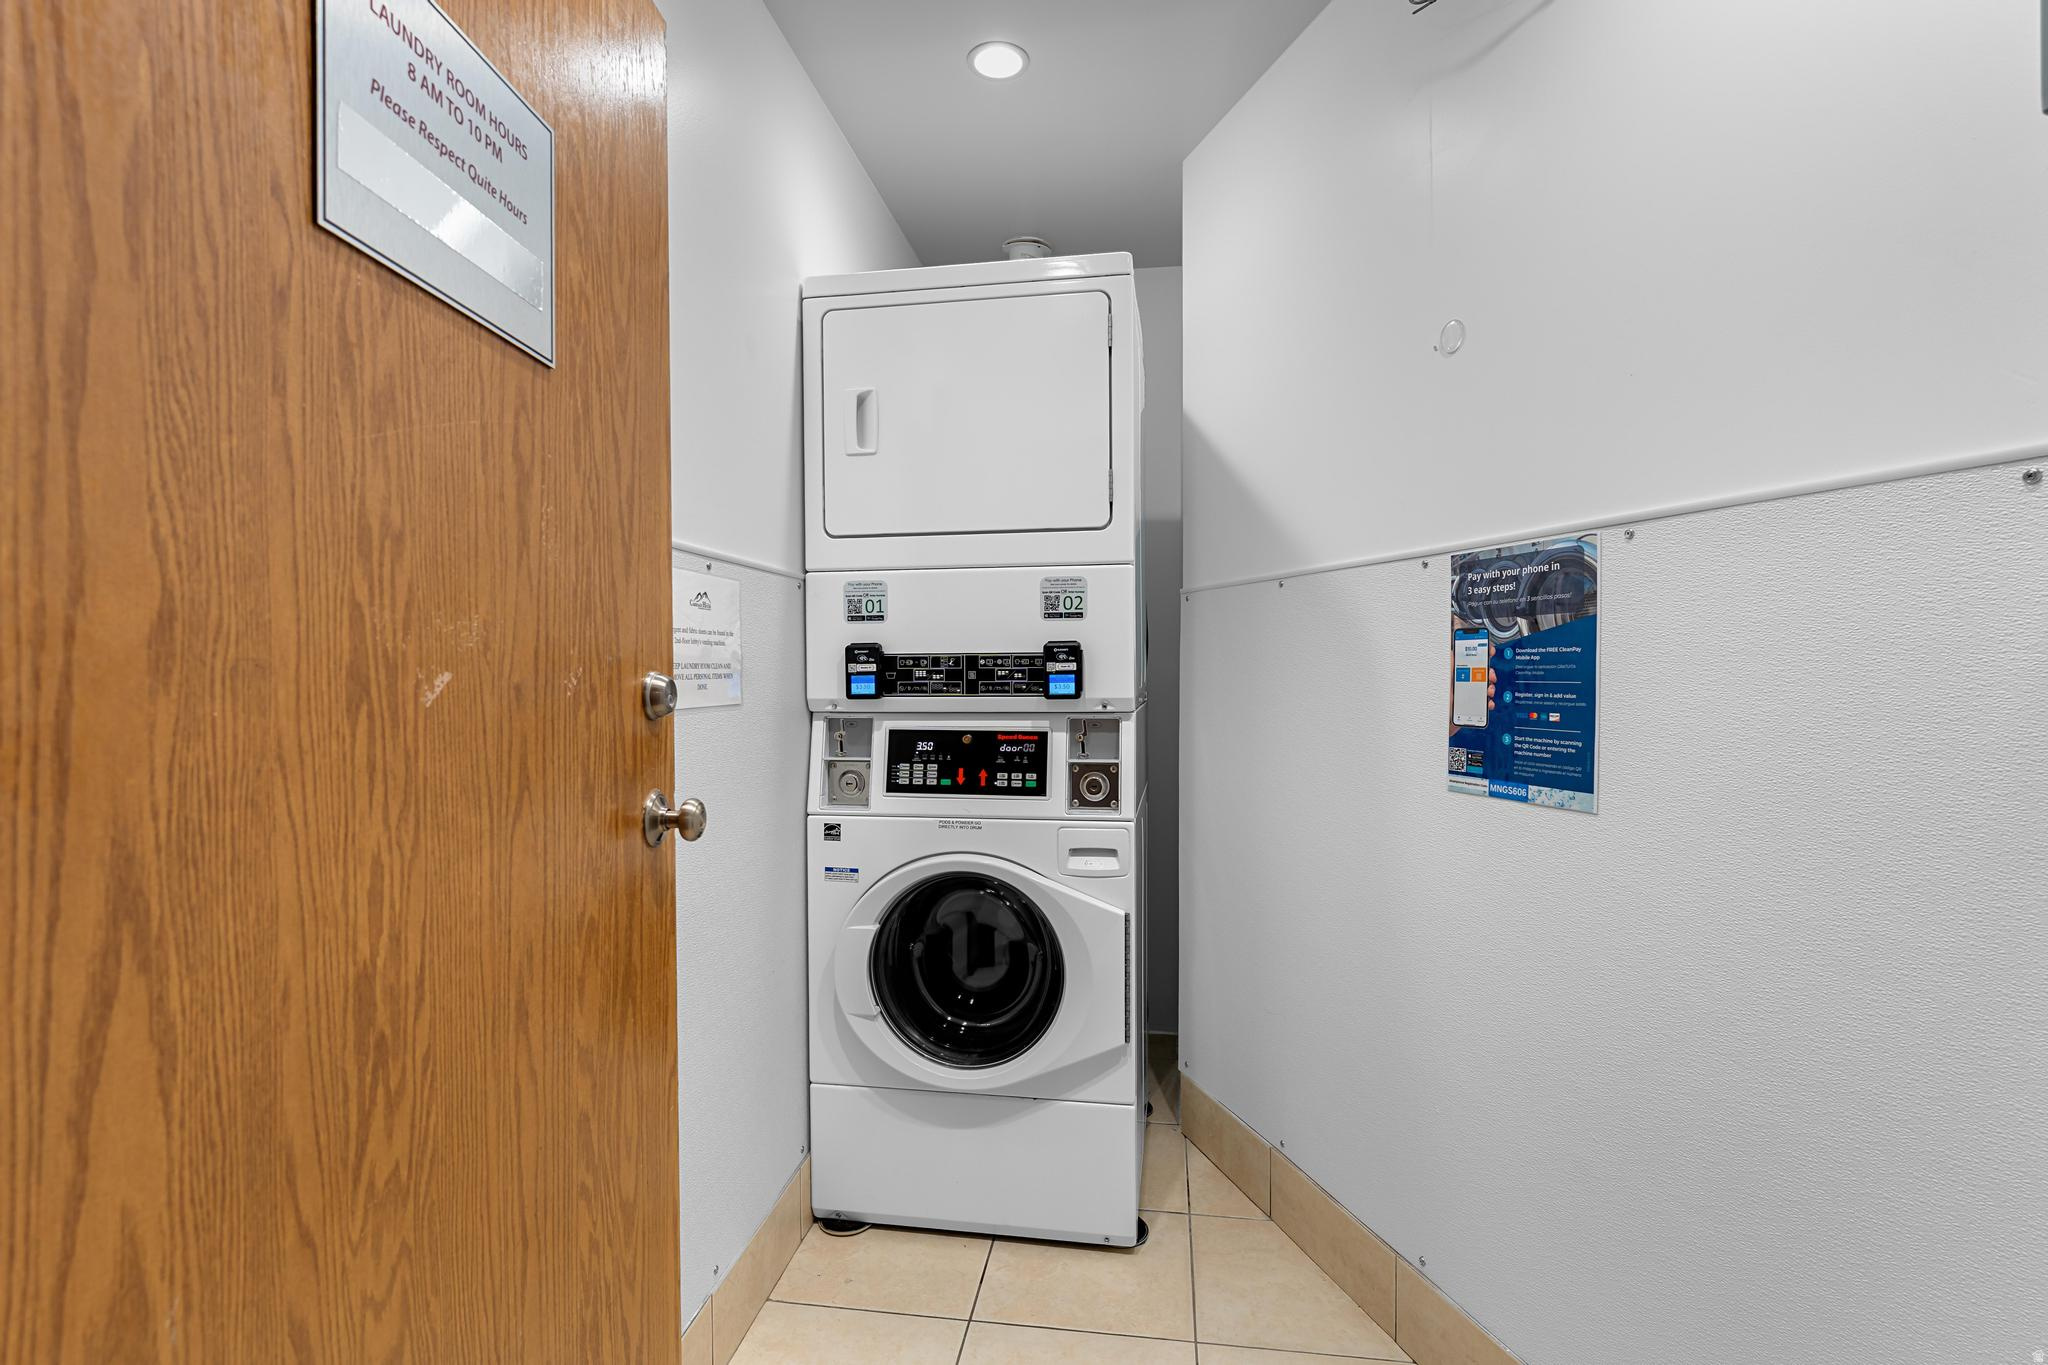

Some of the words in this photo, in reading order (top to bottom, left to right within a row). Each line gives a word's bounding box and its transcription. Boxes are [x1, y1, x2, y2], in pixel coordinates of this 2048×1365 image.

[370, 0, 443, 76] LAUNDRY
[446, 68, 486, 120] ROOM
[489, 109, 528, 161] HOURS
[407, 62, 416, 82] 8
[420, 75, 444, 108] AM
[447, 96, 464, 125] TO
[468, 118, 482, 142] 10
[485, 133, 504, 164] PM
[370, 78, 416, 129] Please
[418, 119, 466, 173] Respect
[468, 163, 498, 200] Quite
[499, 191, 529, 225] Hours
[1467, 572, 1481, 582] Pay
[1482, 570, 1501, 580] with
[1502, 568, 1520, 580] your
[1522, 564, 1550, 577] phone
[1551, 562, 1560, 570] in
[1467, 586, 1473, 595] 3
[1473, 586, 1491, 596] easy
[1492, 582, 1516, 594] steps!
[865, 599, 884, 613] 01
[1063, 596, 1083, 610] 02
[1490, 783, 1527, 797] MNGS606
